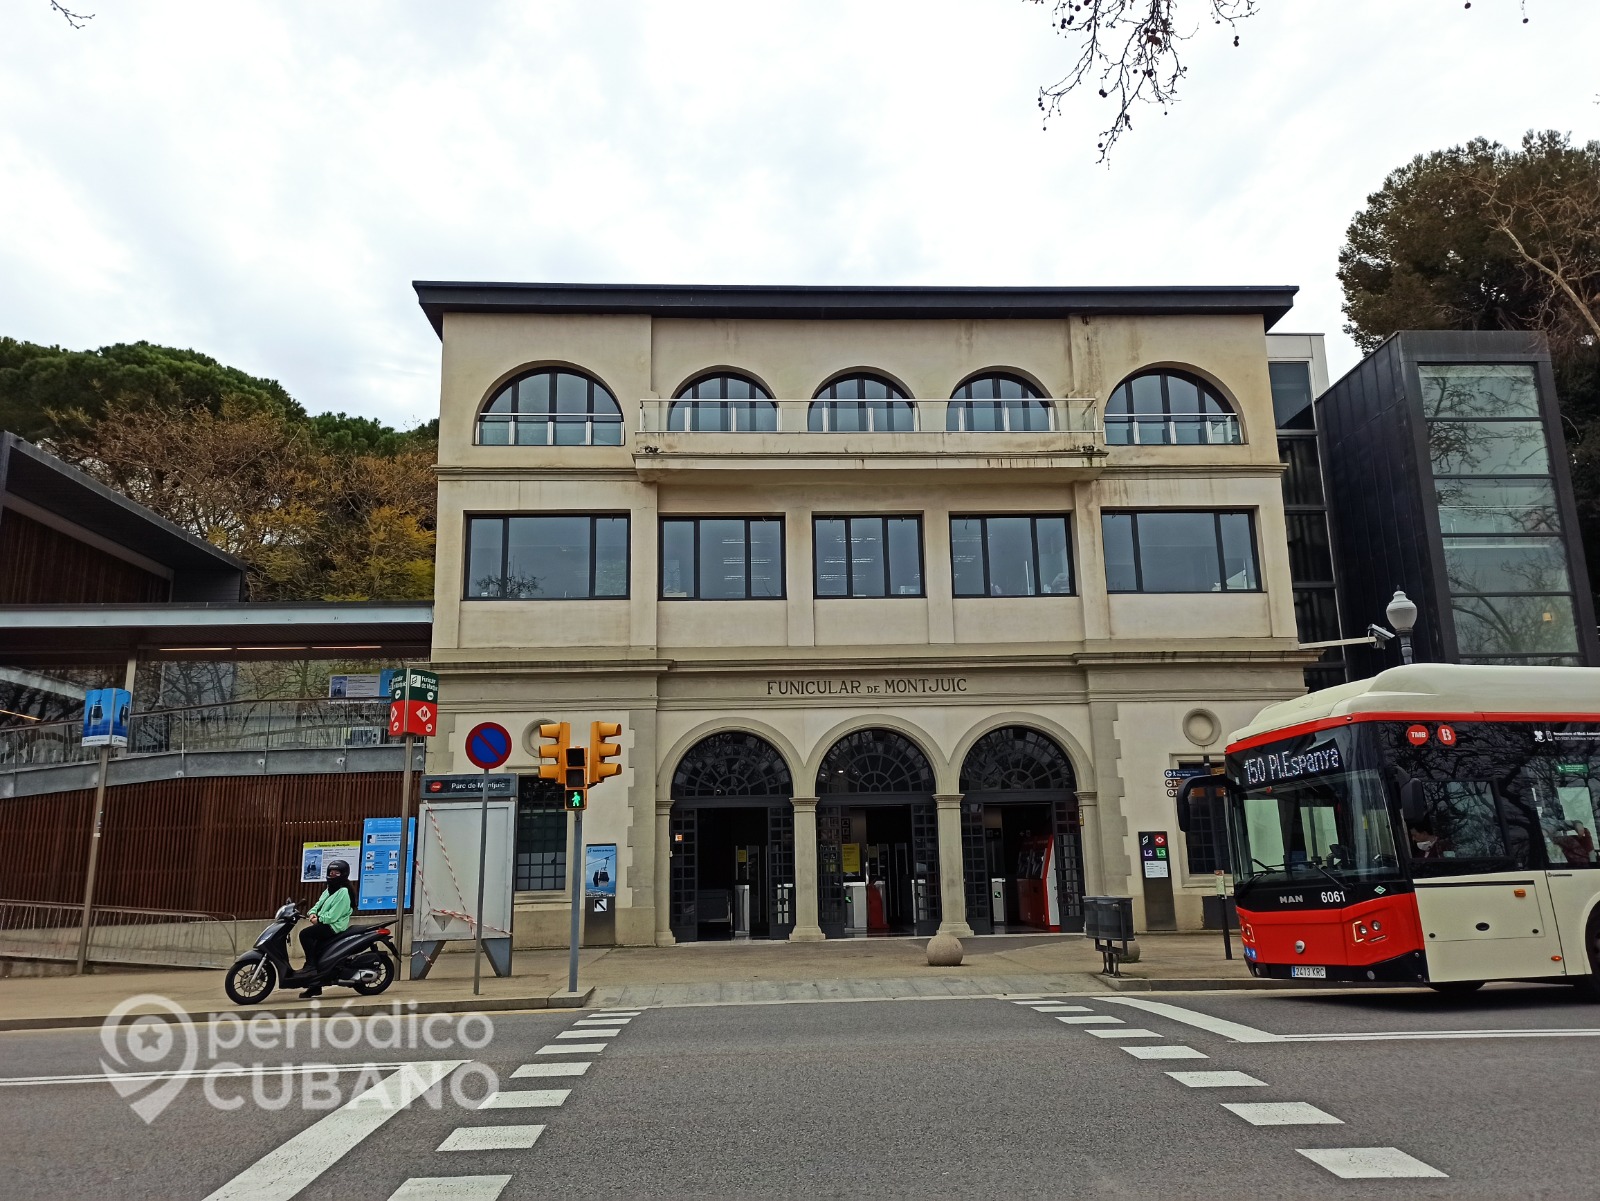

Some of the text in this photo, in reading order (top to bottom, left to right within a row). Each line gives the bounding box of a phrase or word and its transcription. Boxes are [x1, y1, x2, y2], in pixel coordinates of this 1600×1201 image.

[767, 677, 967, 695] FUNICULAR DE MONTJUÏC
[420, 709, 428, 719] M
[1243, 757, 1266, 785] 150
[477, 781, 506, 791] Mntjuïc
[1143, 849, 1153, 857] L2
[1156, 849, 1166, 857] L3
[1279, 894, 1304, 903] MAN
[1321, 891, 1346, 903] 6061
[1295, 967, 1311, 977] 2413
